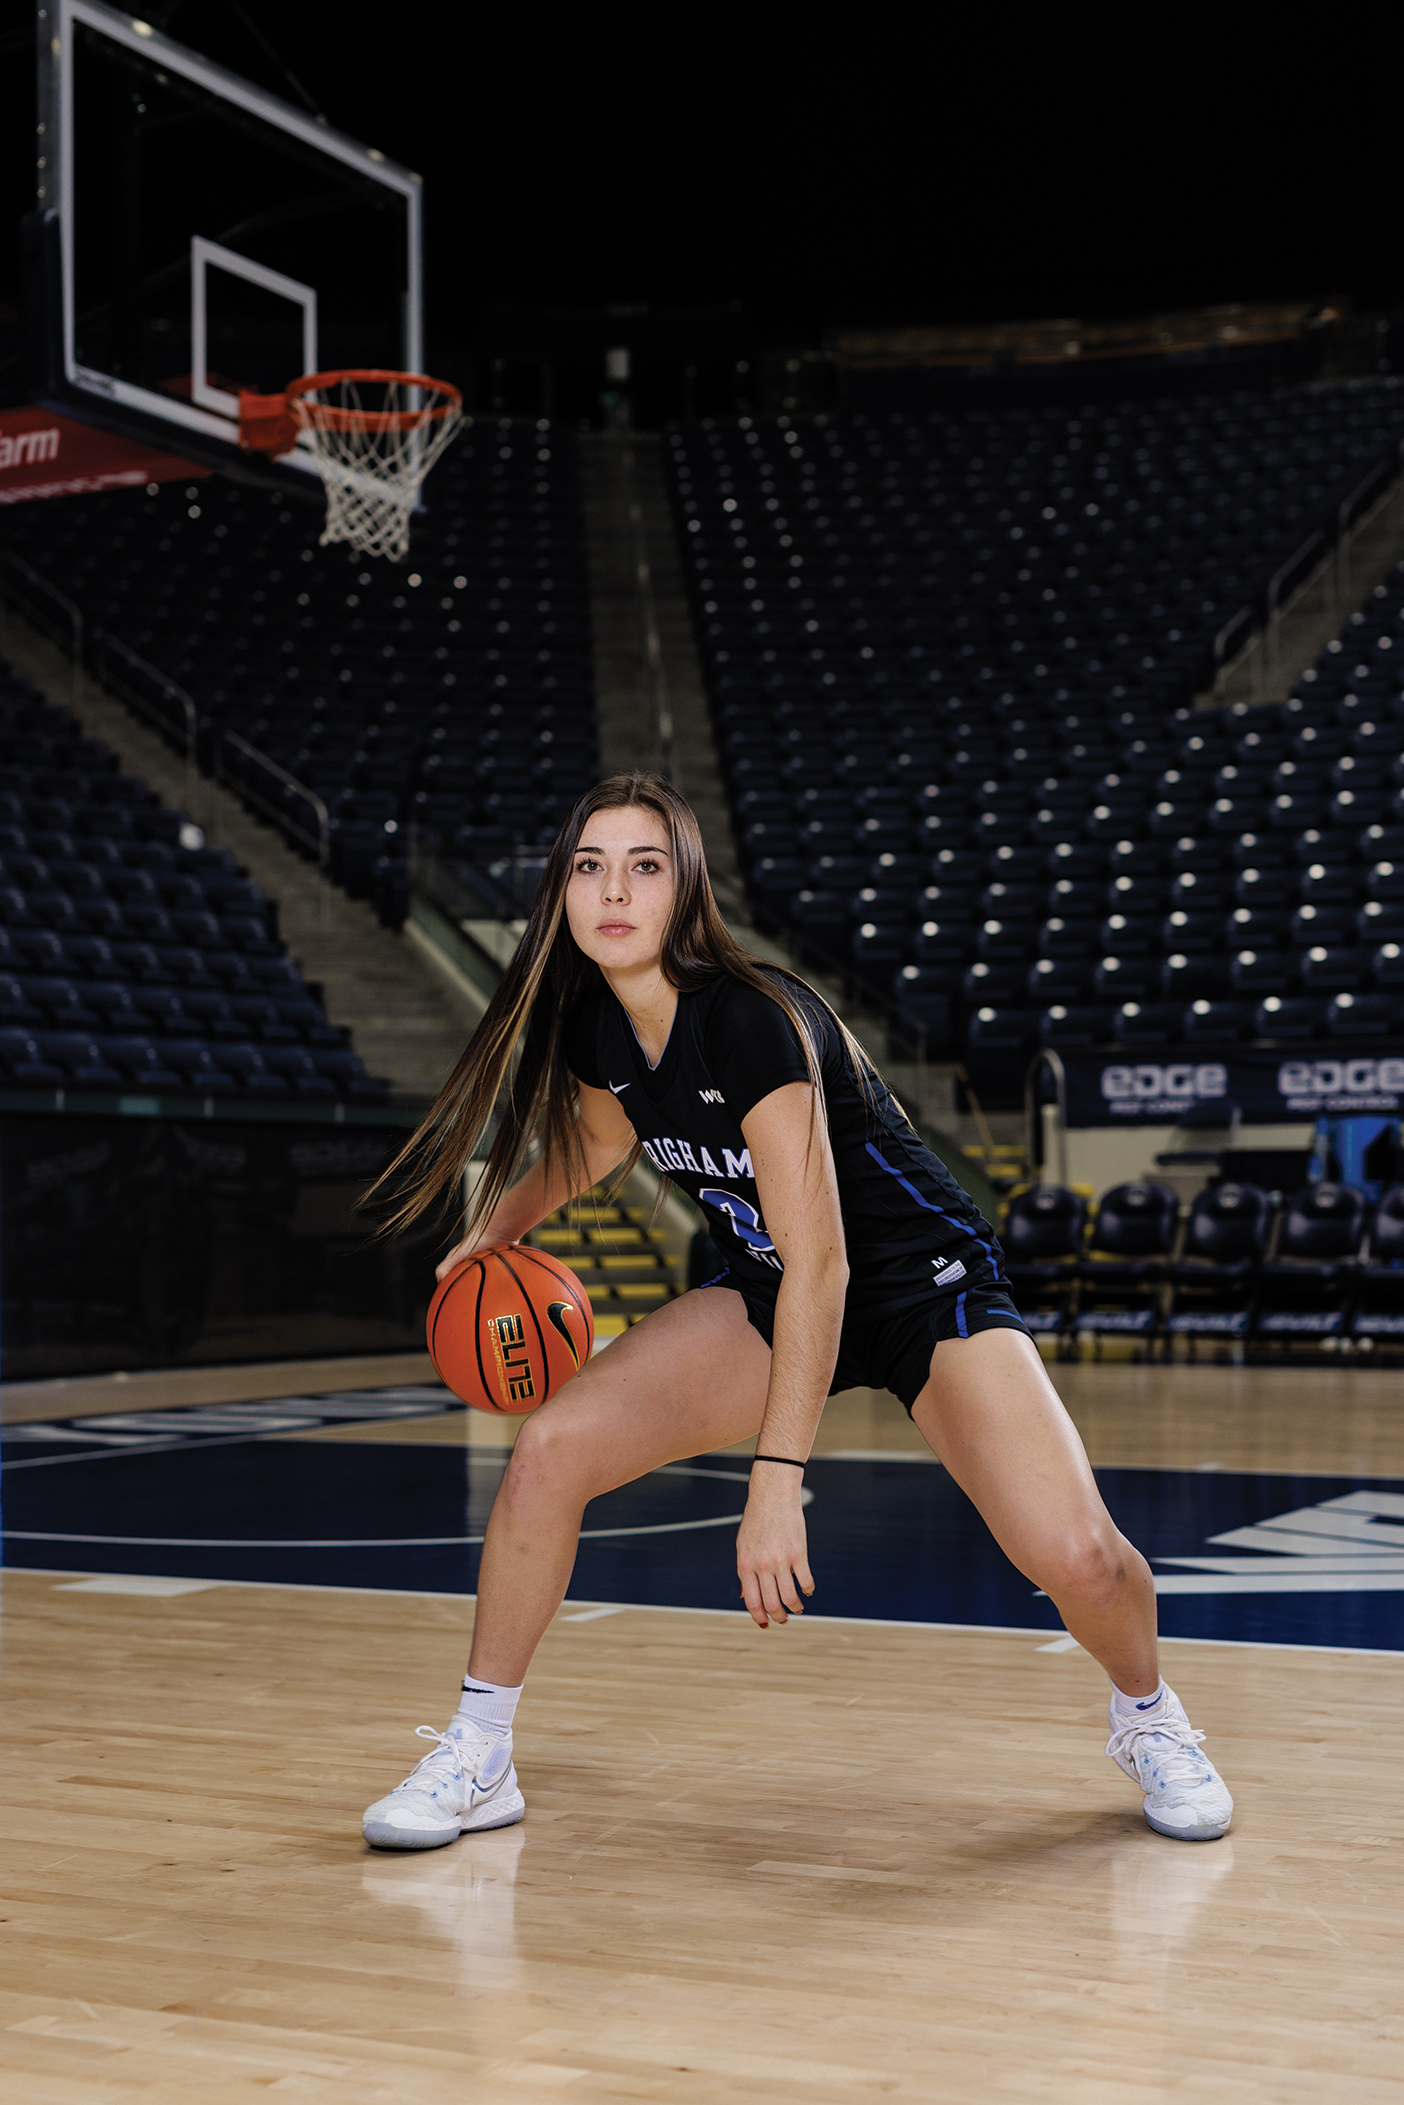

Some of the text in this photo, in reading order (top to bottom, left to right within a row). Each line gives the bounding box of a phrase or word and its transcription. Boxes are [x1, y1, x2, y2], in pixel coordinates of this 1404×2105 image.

[0, 427, 60, 470] arm
[641, 1136, 756, 1179] RIGHAM
[930, 1255, 949, 1270] M
[495, 1313, 536, 1403] ELITE
